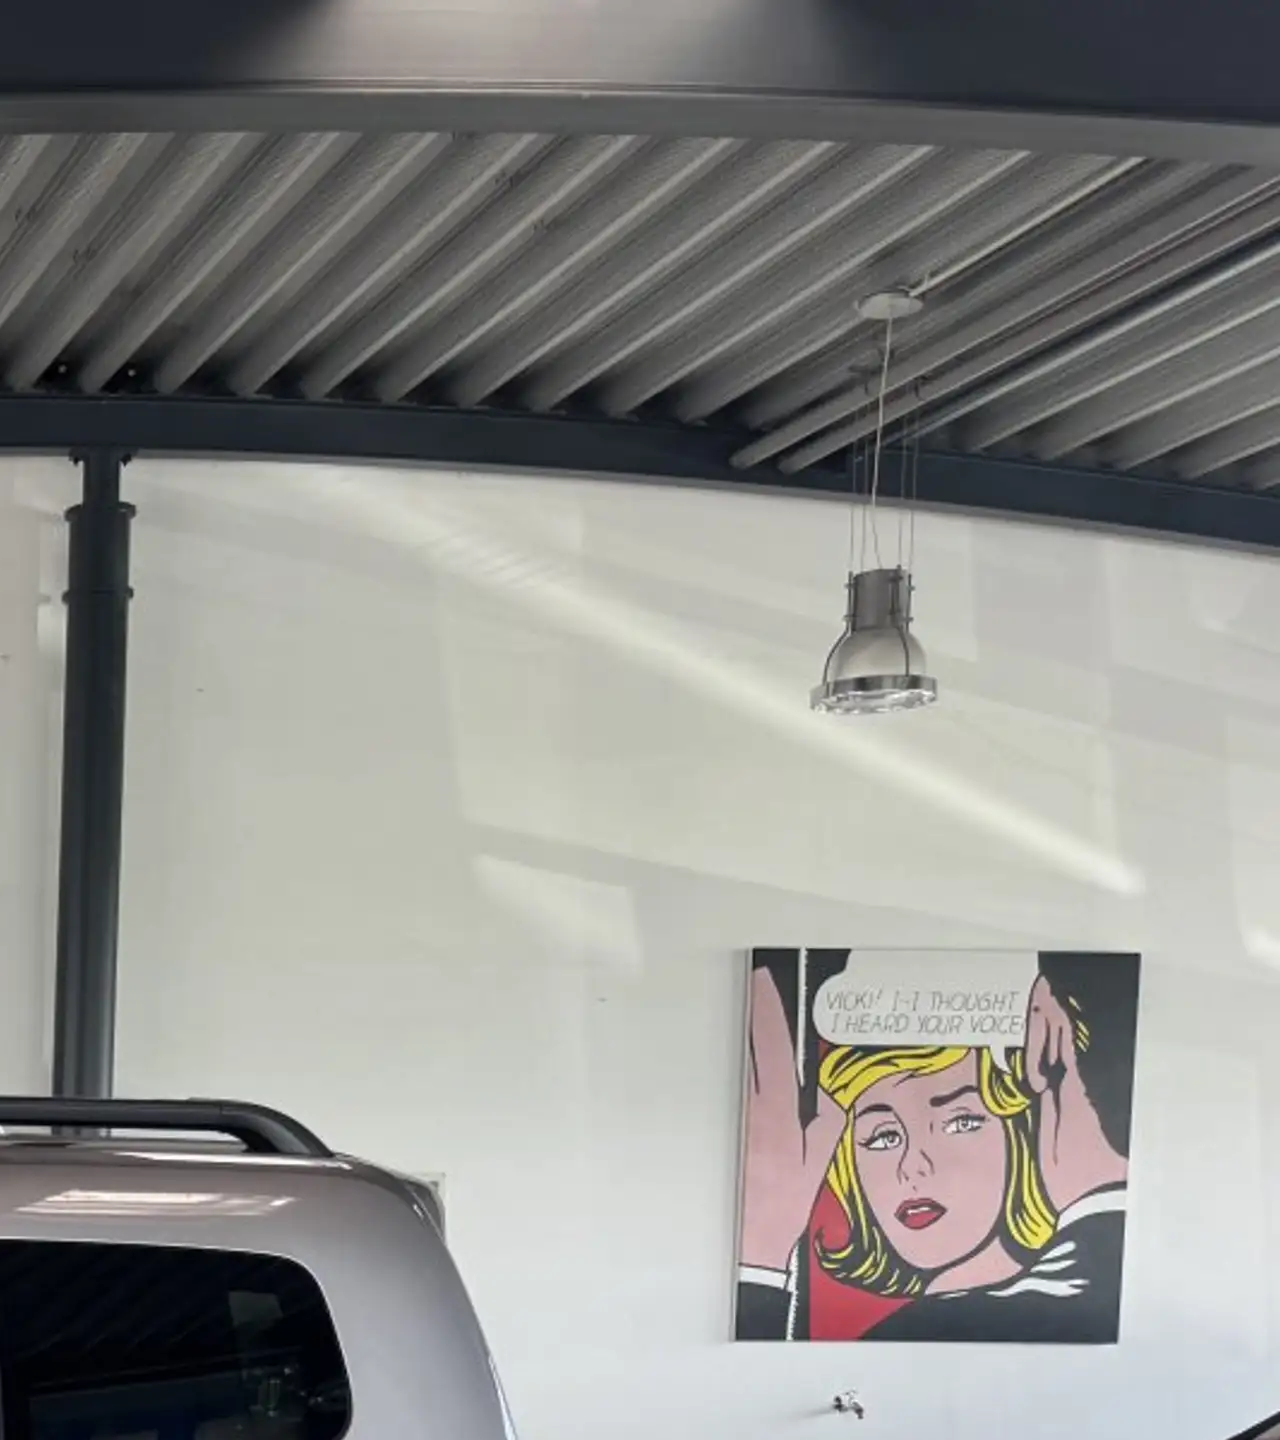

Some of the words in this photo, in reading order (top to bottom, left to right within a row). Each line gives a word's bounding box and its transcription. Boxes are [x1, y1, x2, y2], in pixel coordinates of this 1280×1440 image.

[929, 991, 1021, 1012] THOUGHT
[831, 1012, 840, 1033] I
[846, 1013, 909, 1033] HEARD
[917, 1014, 964, 1035] YOUR
